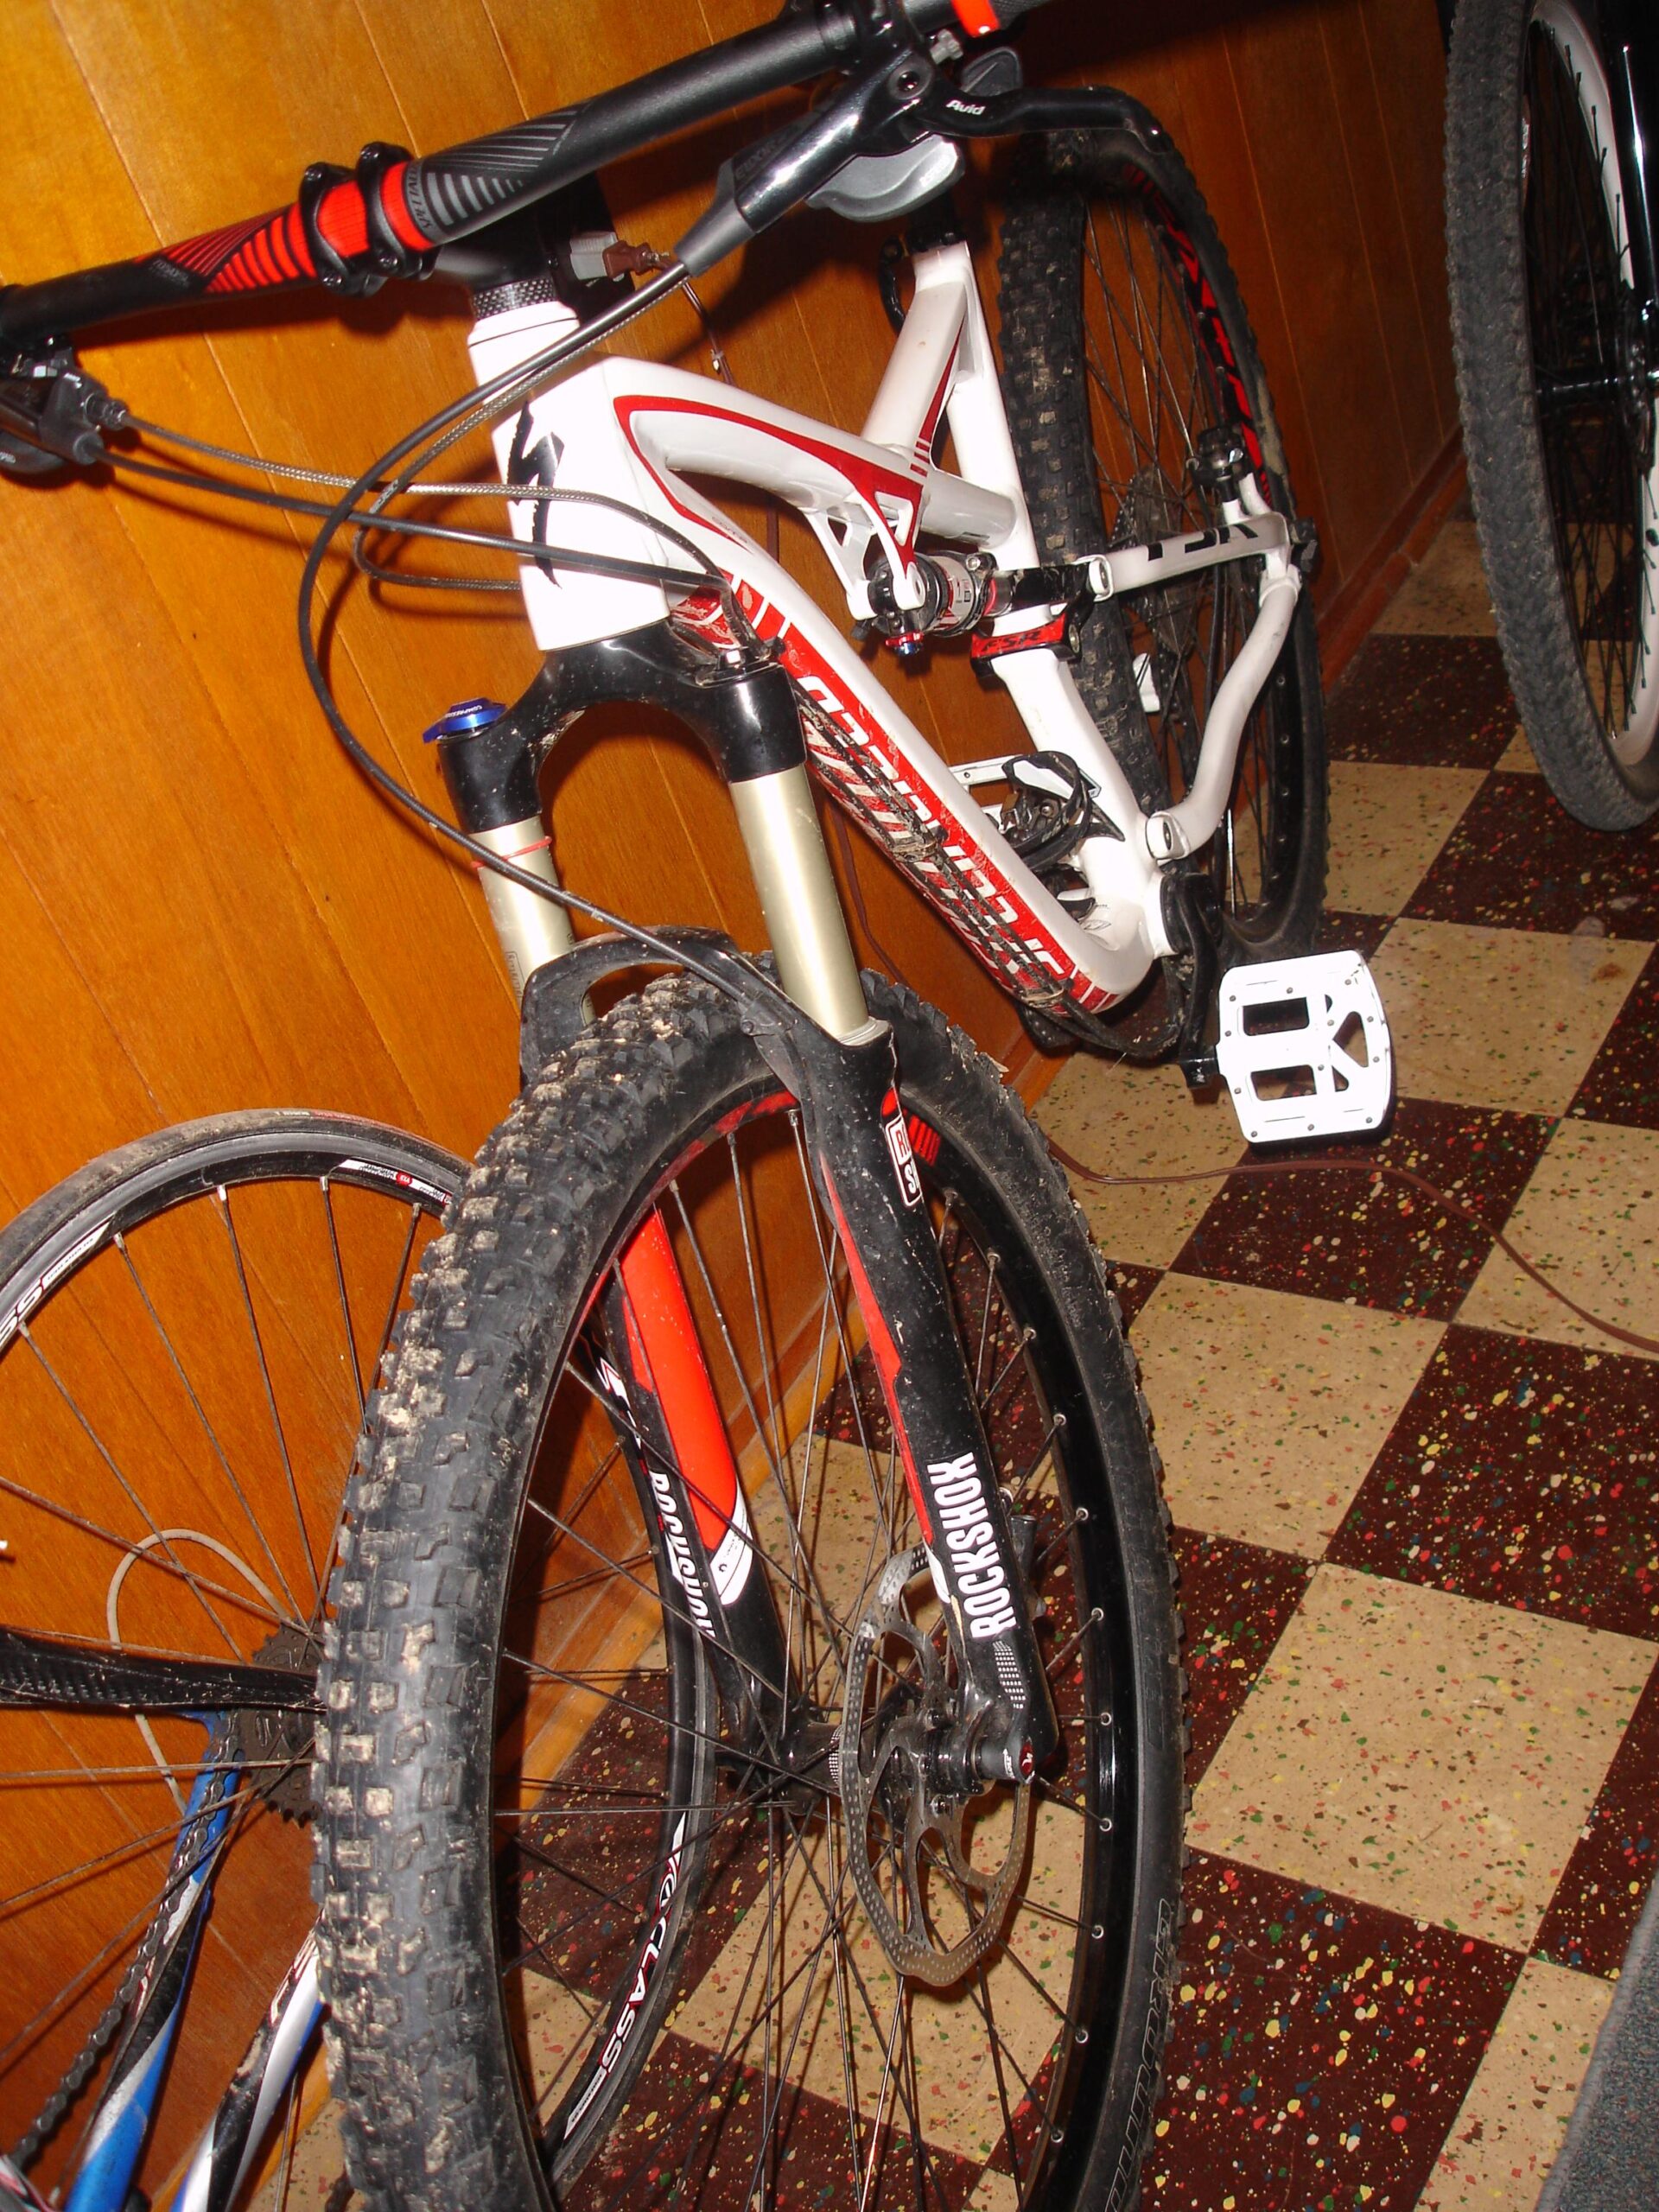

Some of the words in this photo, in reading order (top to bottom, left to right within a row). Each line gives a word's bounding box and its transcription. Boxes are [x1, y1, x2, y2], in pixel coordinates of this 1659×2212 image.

[945, 99, 986, 115] Avid
[982, 631, 1042, 652] FSR
[927, 1452, 1017, 1638] ROCKSHOX
